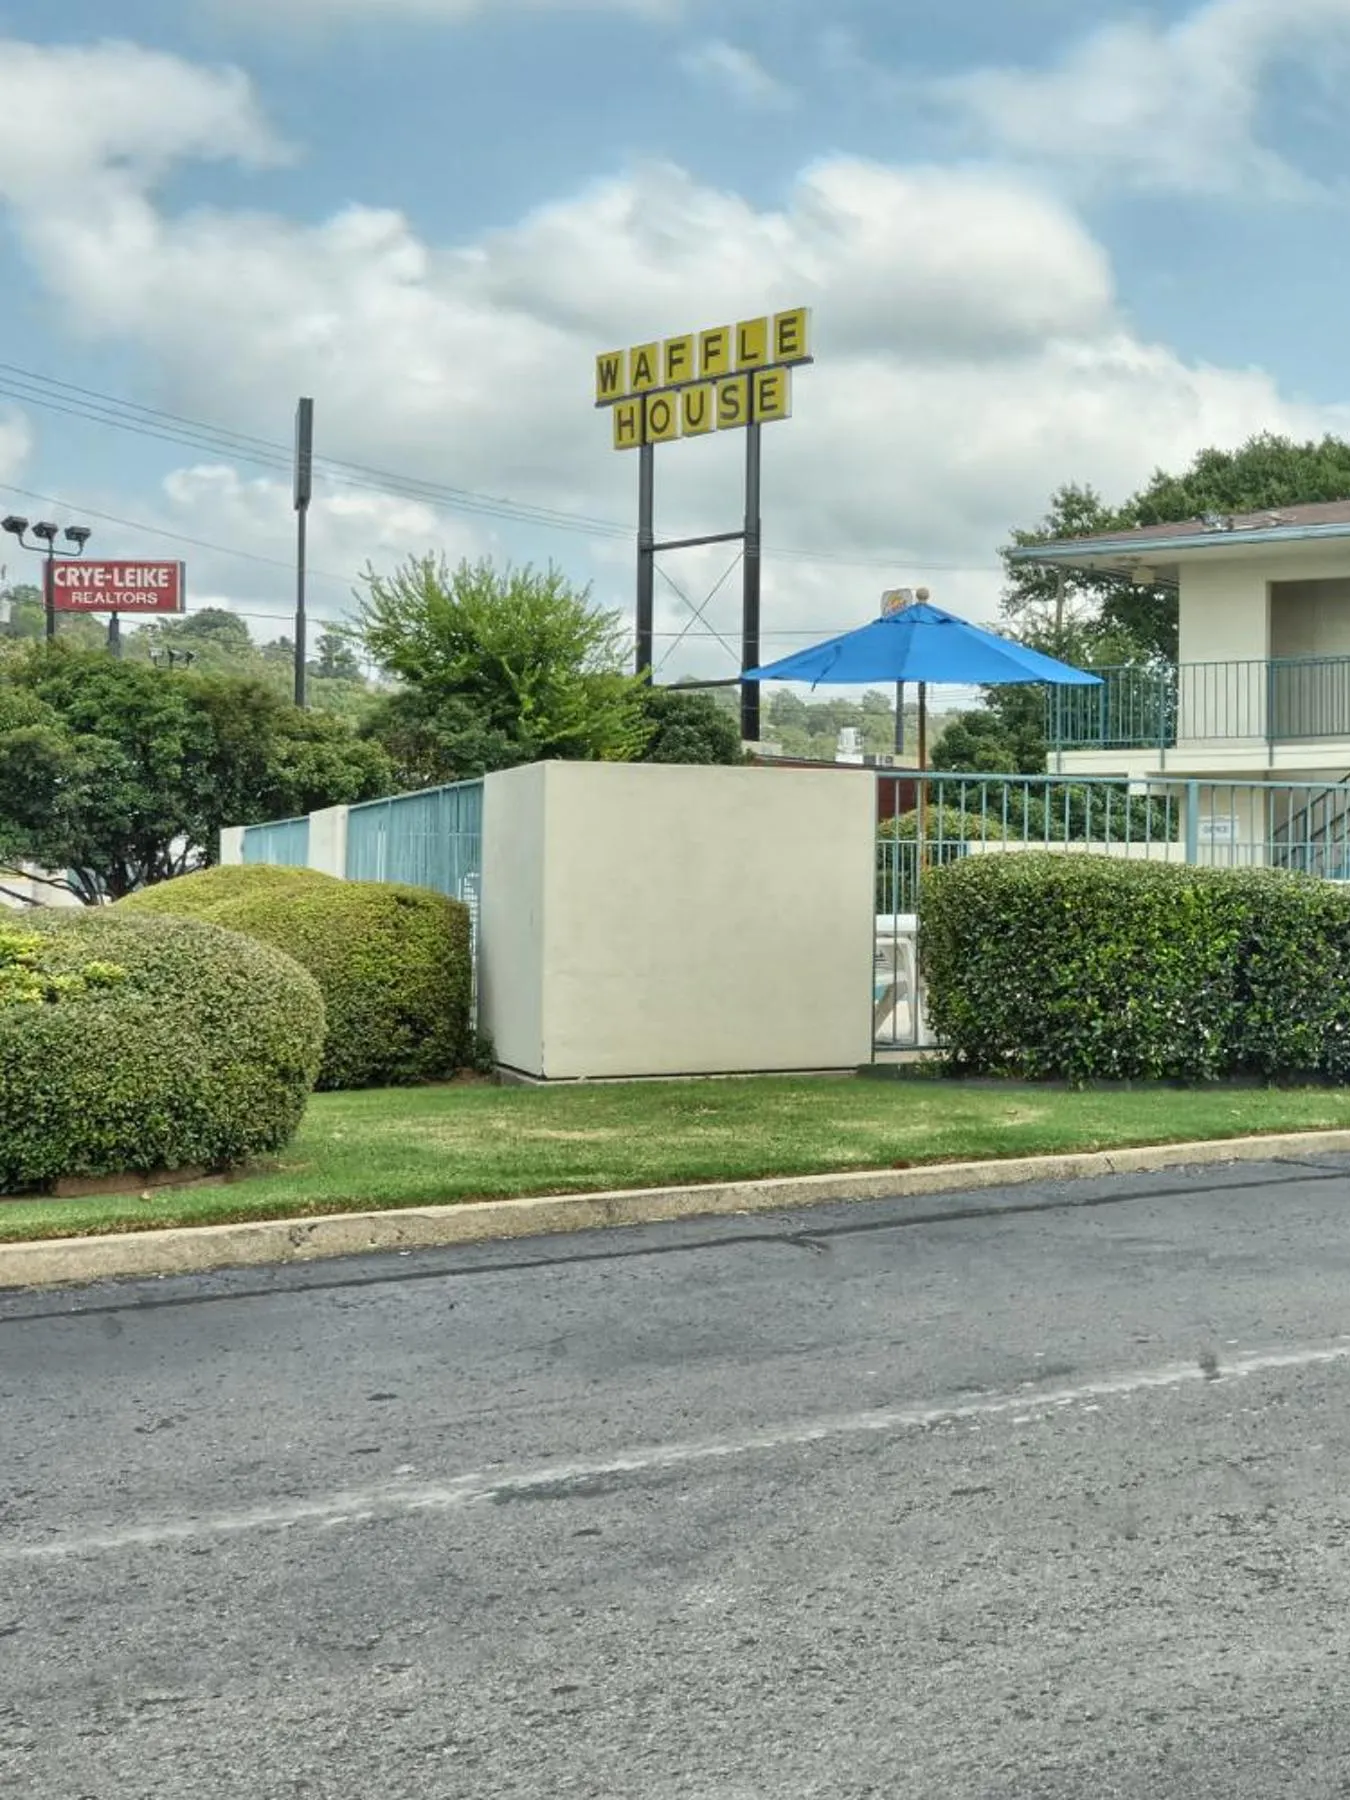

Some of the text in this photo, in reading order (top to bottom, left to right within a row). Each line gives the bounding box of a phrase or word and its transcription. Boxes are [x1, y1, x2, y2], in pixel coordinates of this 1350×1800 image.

[598, 316, 798, 393] WAFFLE
[617, 377, 779, 441] HOUSE
[54, 567, 169, 588] CRYE-LEIKE
[71, 591, 158, 605] REALTORS
